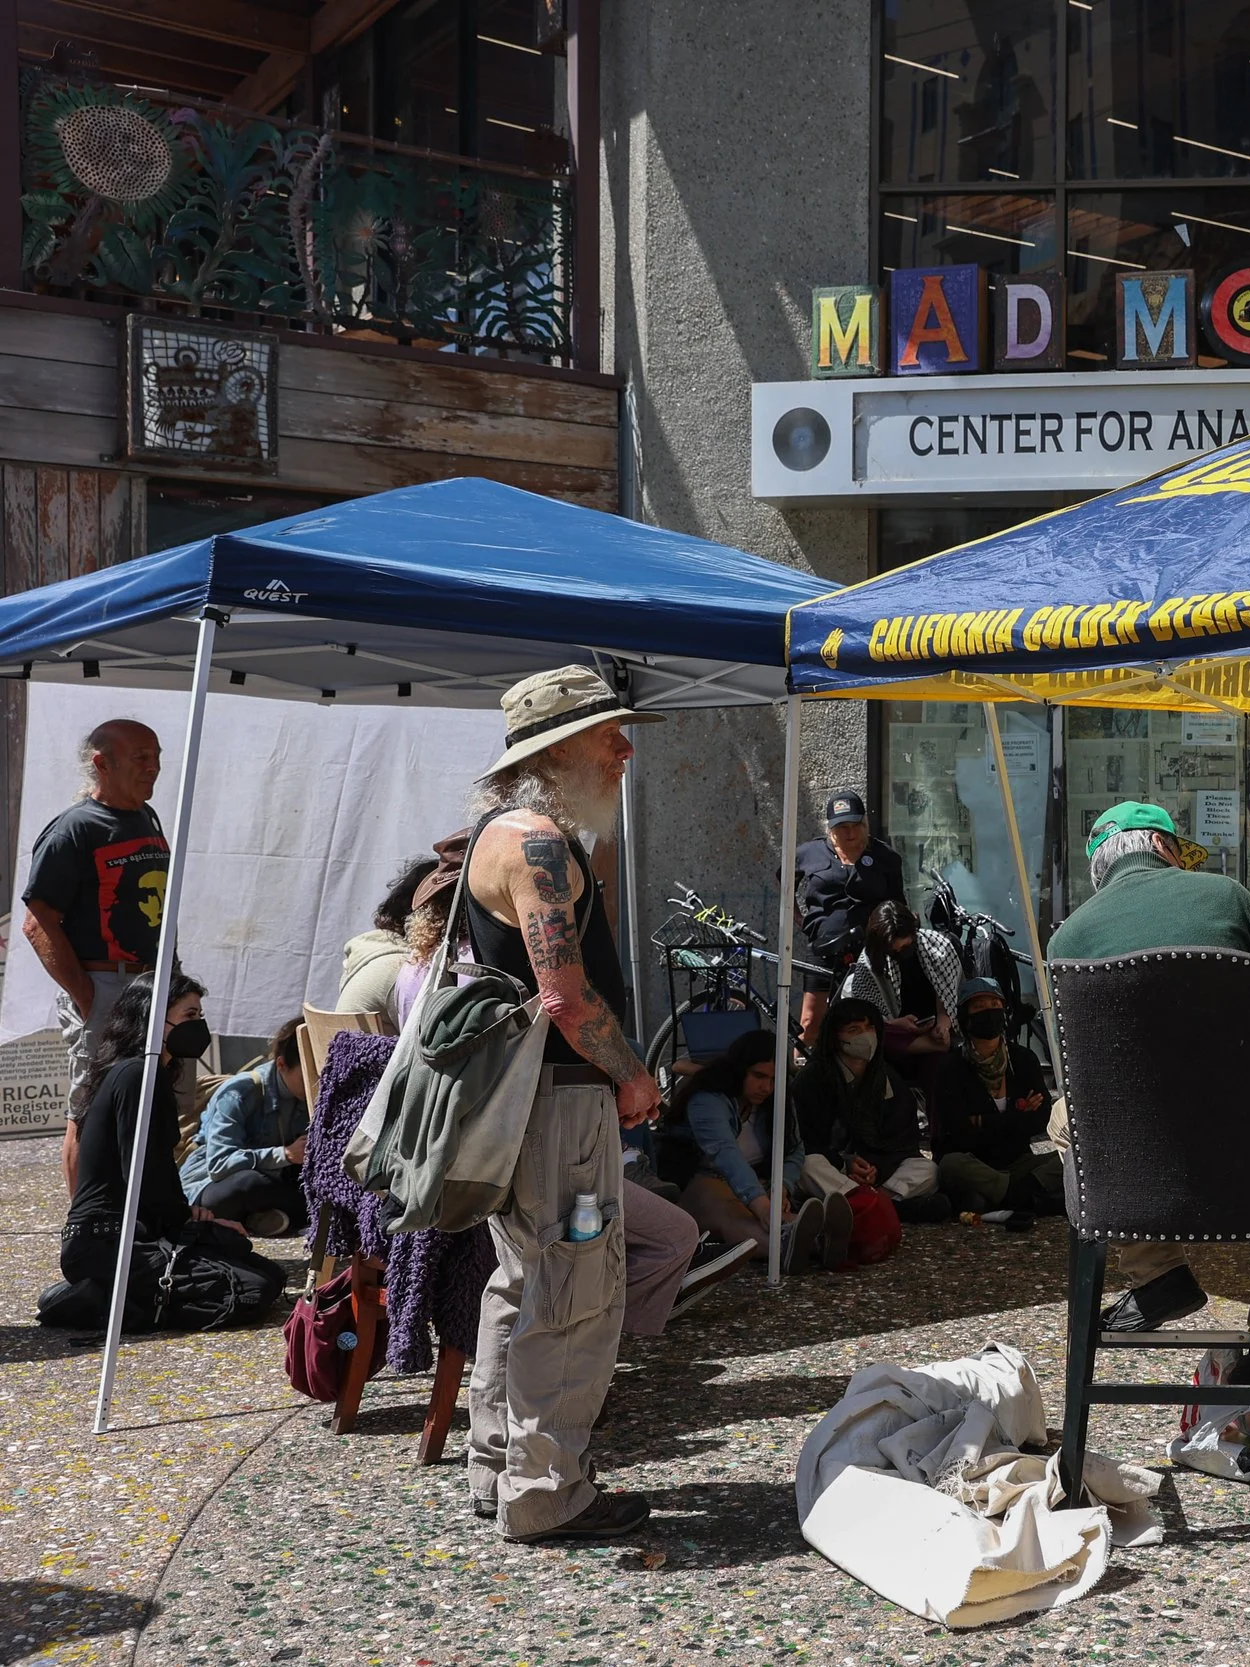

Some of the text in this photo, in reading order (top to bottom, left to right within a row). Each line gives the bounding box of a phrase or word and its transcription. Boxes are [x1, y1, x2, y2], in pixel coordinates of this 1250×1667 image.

[816, 274, 1053, 369] MAD
[908, 412, 1064, 457] CENTER
[1075, 409, 1154, 453] FOR
[243, 588, 309, 604] QUEST
[867, 607, 1025, 663] CALIFORNIA
[1022, 600, 1152, 652] GOLDEN
[3, 1100, 65, 1114] Register
